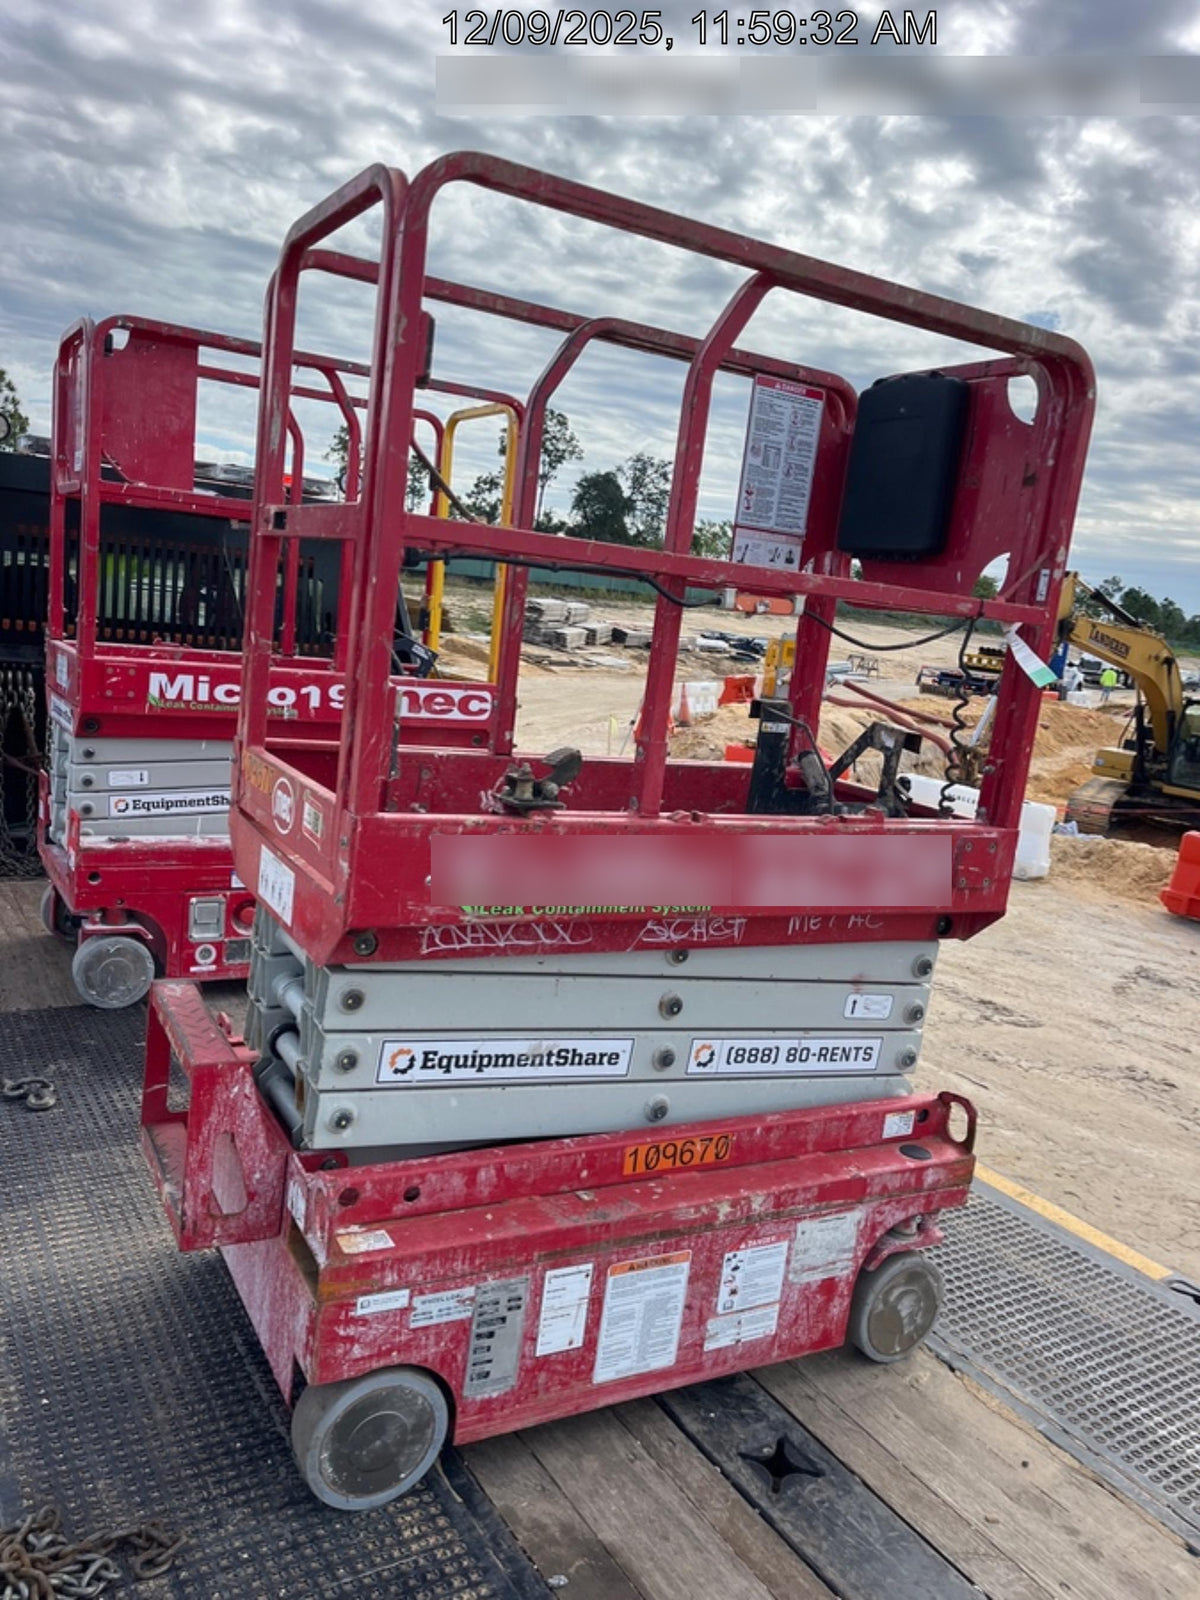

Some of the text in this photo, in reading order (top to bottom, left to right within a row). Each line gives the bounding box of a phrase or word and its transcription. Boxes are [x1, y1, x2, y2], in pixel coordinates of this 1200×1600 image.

[149, 671, 346, 711] Mico19
[132, 794, 231, 812] EquipmentSh
[420, 1048, 620, 1074] EquipmentShare
[726, 1046, 874, 1065] (888) 80-RENTS
[628, 1134, 730, 1173] 109670
